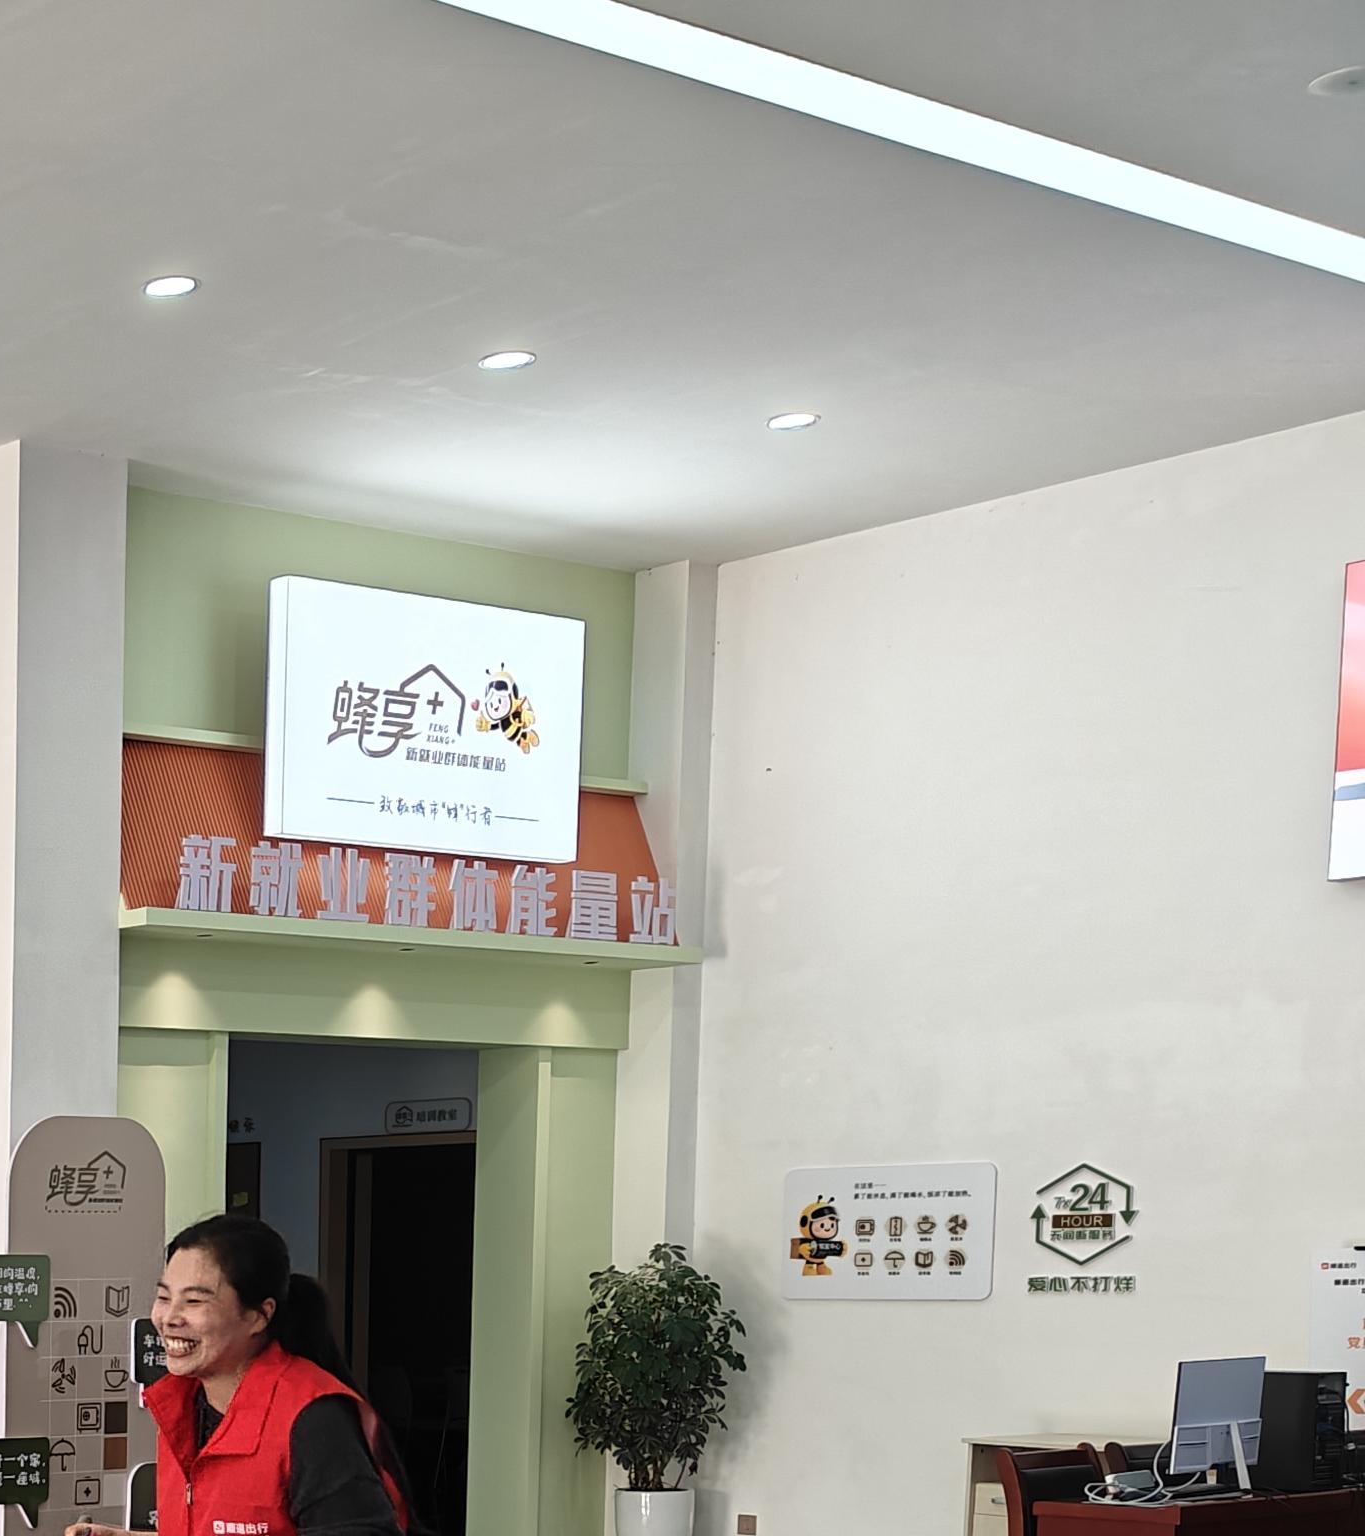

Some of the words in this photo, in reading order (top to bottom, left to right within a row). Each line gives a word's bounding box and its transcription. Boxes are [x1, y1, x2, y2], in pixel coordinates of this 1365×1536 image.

[404, 746, 507, 772] 新就业群体能量站
[174, 834, 678, 945] 新就业群体能量站
[416, 1108, 458, 1124] 培训教室
[1069, 1182, 1110, 1212] 24
[1060, 1215, 1104, 1227] HOUR
[1027, 1276, 1136, 1293] 爱心不打烊
[225, 1521, 270, 1535] 顺道出行
